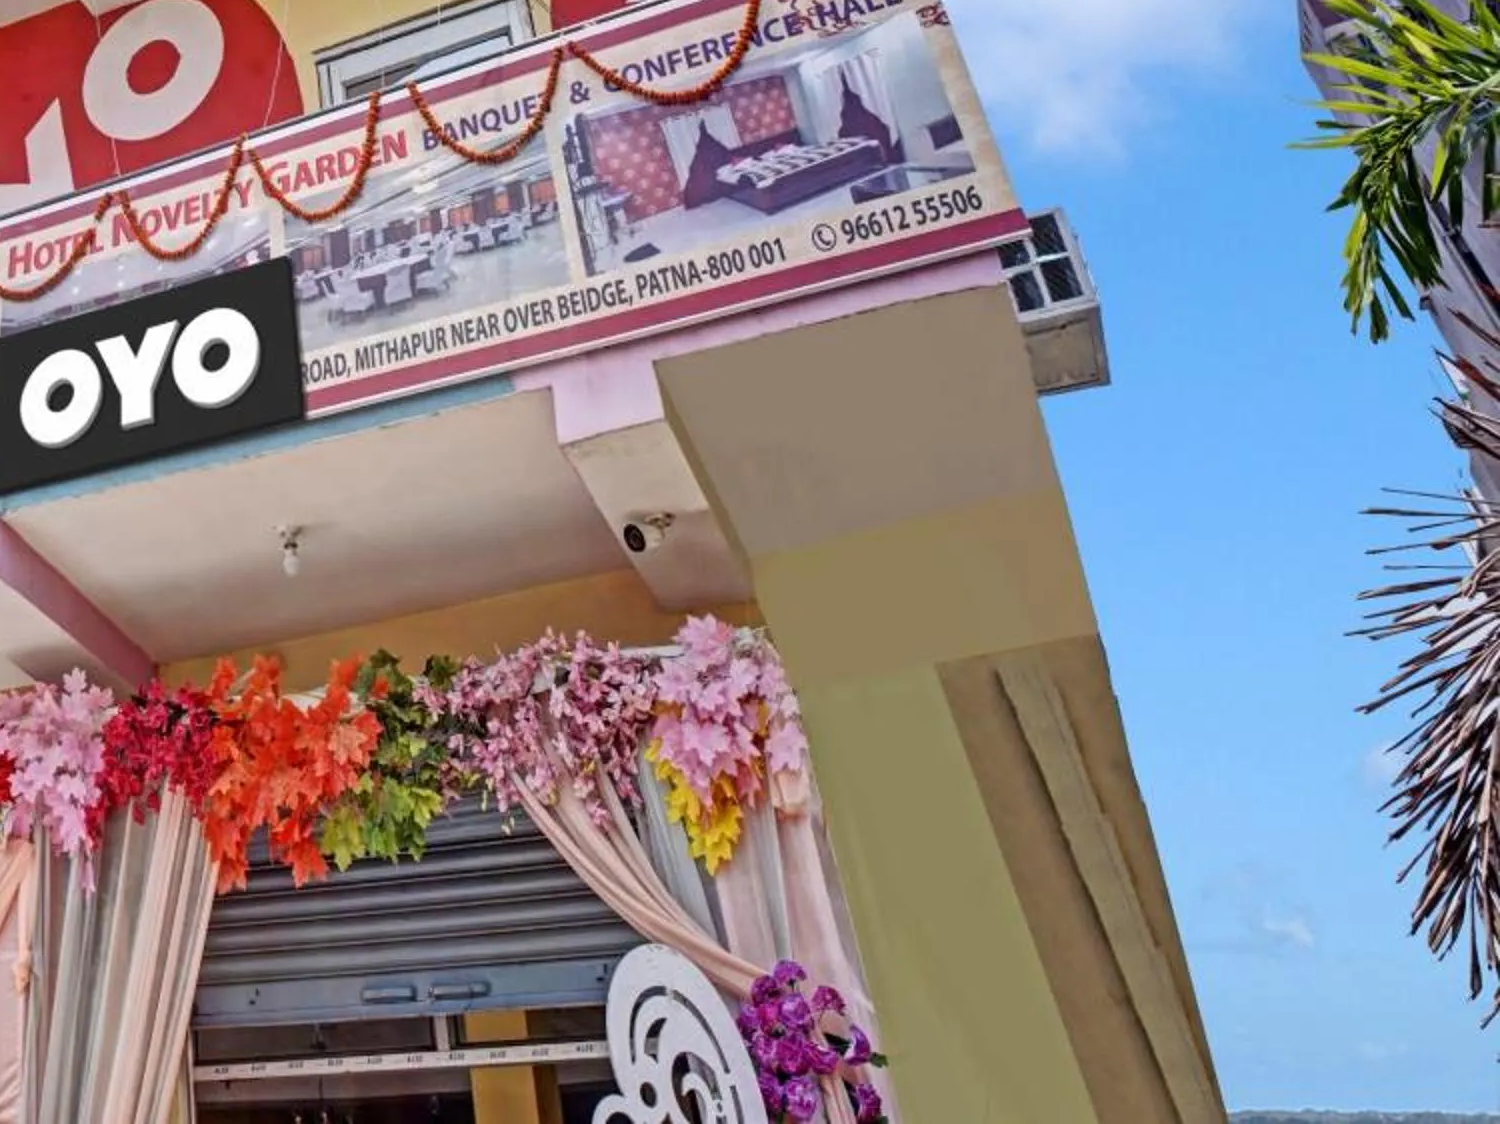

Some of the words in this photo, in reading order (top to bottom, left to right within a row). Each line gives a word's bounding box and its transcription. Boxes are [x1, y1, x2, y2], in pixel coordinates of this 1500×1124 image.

[8, 227, 105, 281] HOTEL
[111, 178, 256, 247] NOVELTY
[267, 129, 410, 198] GARDEN
[421, 91, 546, 152] BANQUET
[568, 80, 591, 105] &
[602, 10, 805, 94] CONFERENCE
[355, 324, 449, 374] MITHAPUR
[451, 310, 501, 348] NEAR
[503, 295, 556, 334] OVER
[557, 276, 634, 319] BEIDGE,
[637, 252, 747, 300] PATNA-800
[749, 237, 787, 268] 001
[841, 205, 910, 245] 96612
[913, 185, 984, 226] 55506
[19, 307, 260, 449] OYO
